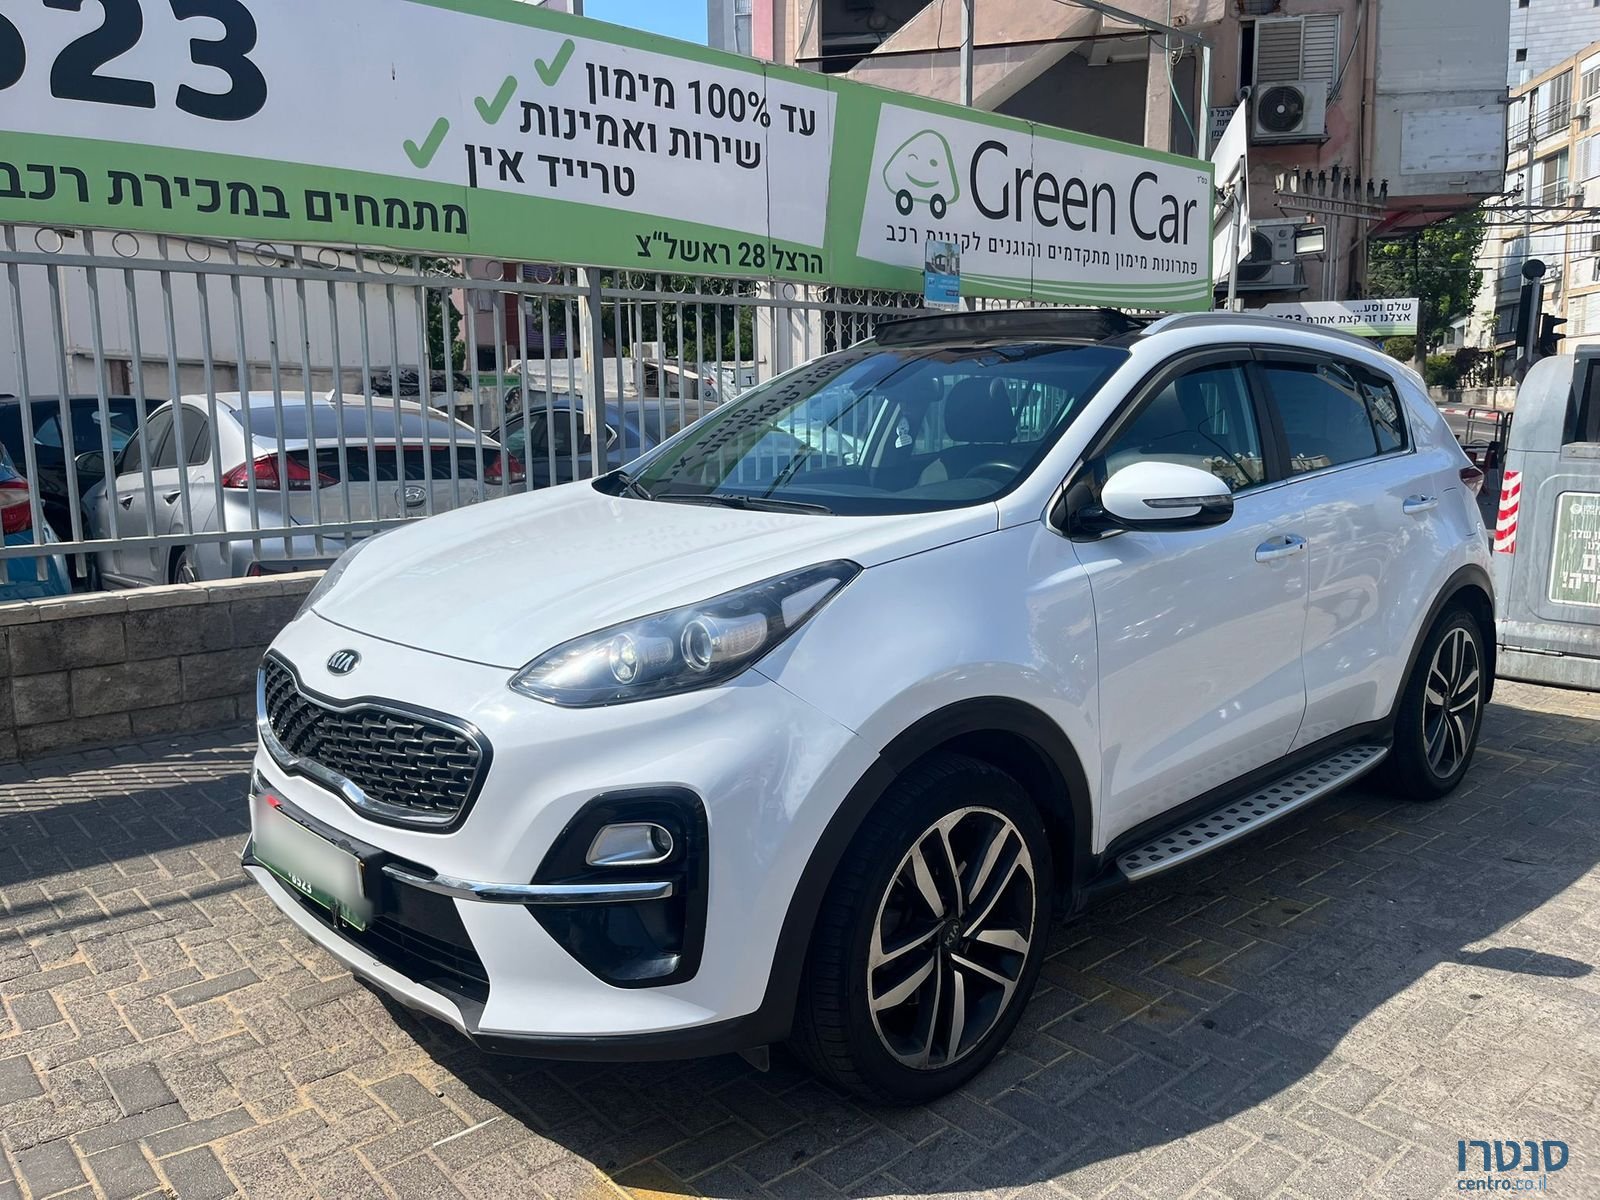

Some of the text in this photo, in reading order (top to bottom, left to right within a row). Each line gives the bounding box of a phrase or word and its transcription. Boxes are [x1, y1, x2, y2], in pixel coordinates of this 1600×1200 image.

[585, 62, 817, 136] עד 100% מימון
[519, 100, 761, 169] שירות ואמינות
[464, 143, 635, 197] טרייד אין
[107, 170, 290, 220] במכירת
[969, 139, 1197, 246] Green Car
[304, 189, 468, 235] מתמחים
[886, 224, 918, 244] רכב
[737, 241, 767, 268] 28
[988, 237, 1041, 258] והוגנים
[1048, 244, 1110, 267] מתקדמים
[772, 244, 823, 275] הרצל
[1115, 252, 1147, 271] מימון
[1152, 256, 1198, 275] פתרונות
[1364, 313, 1377, 323] זה
[1380, 312, 1411, 323] אצלנו
[1386, 302, 1411, 312] שלם
[1338, 314, 1361, 325] קצת
[328, 651, 355, 672] KIA
